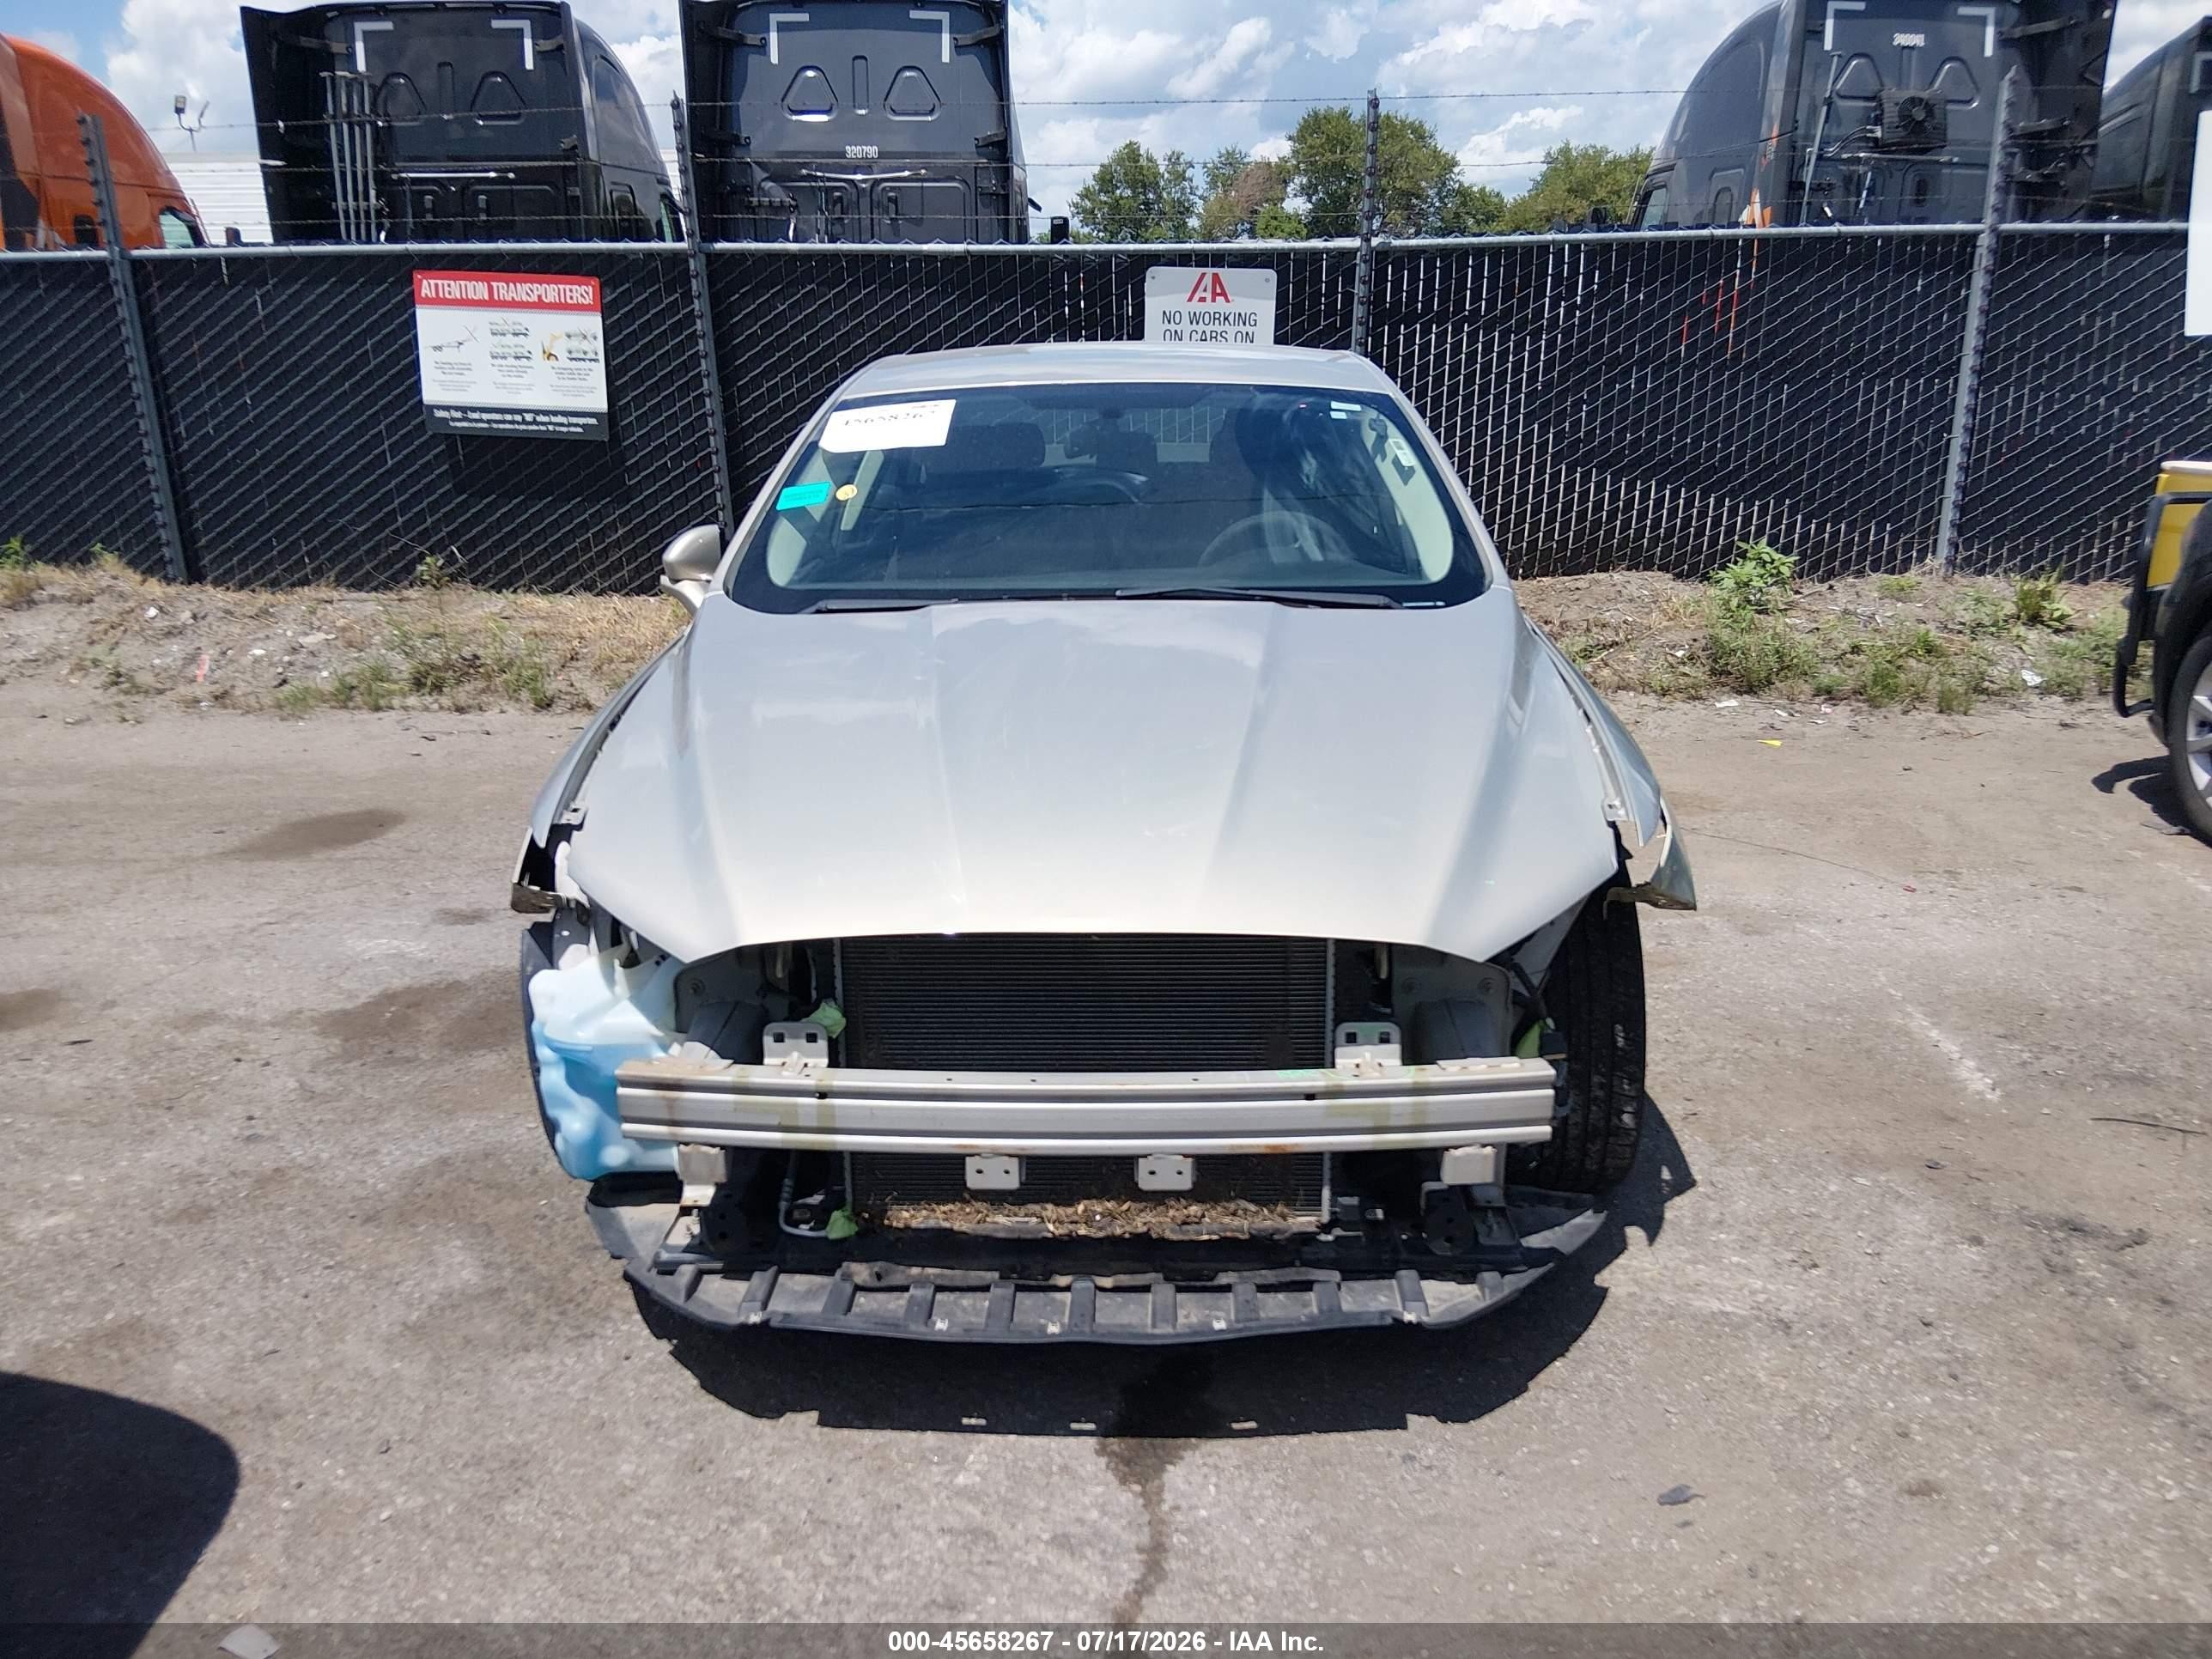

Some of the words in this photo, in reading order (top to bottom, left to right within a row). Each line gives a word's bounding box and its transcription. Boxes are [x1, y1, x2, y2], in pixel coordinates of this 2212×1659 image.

[421, 279, 488, 301] ATTENTION
[492, 282, 594, 305] TRANSPORTERS!
[1162, 310, 1182, 325] NO
[1188, 311, 1258, 327] WORKING
[1163, 329, 1183, 342] ON
[1234, 331, 1255, 343] ON
